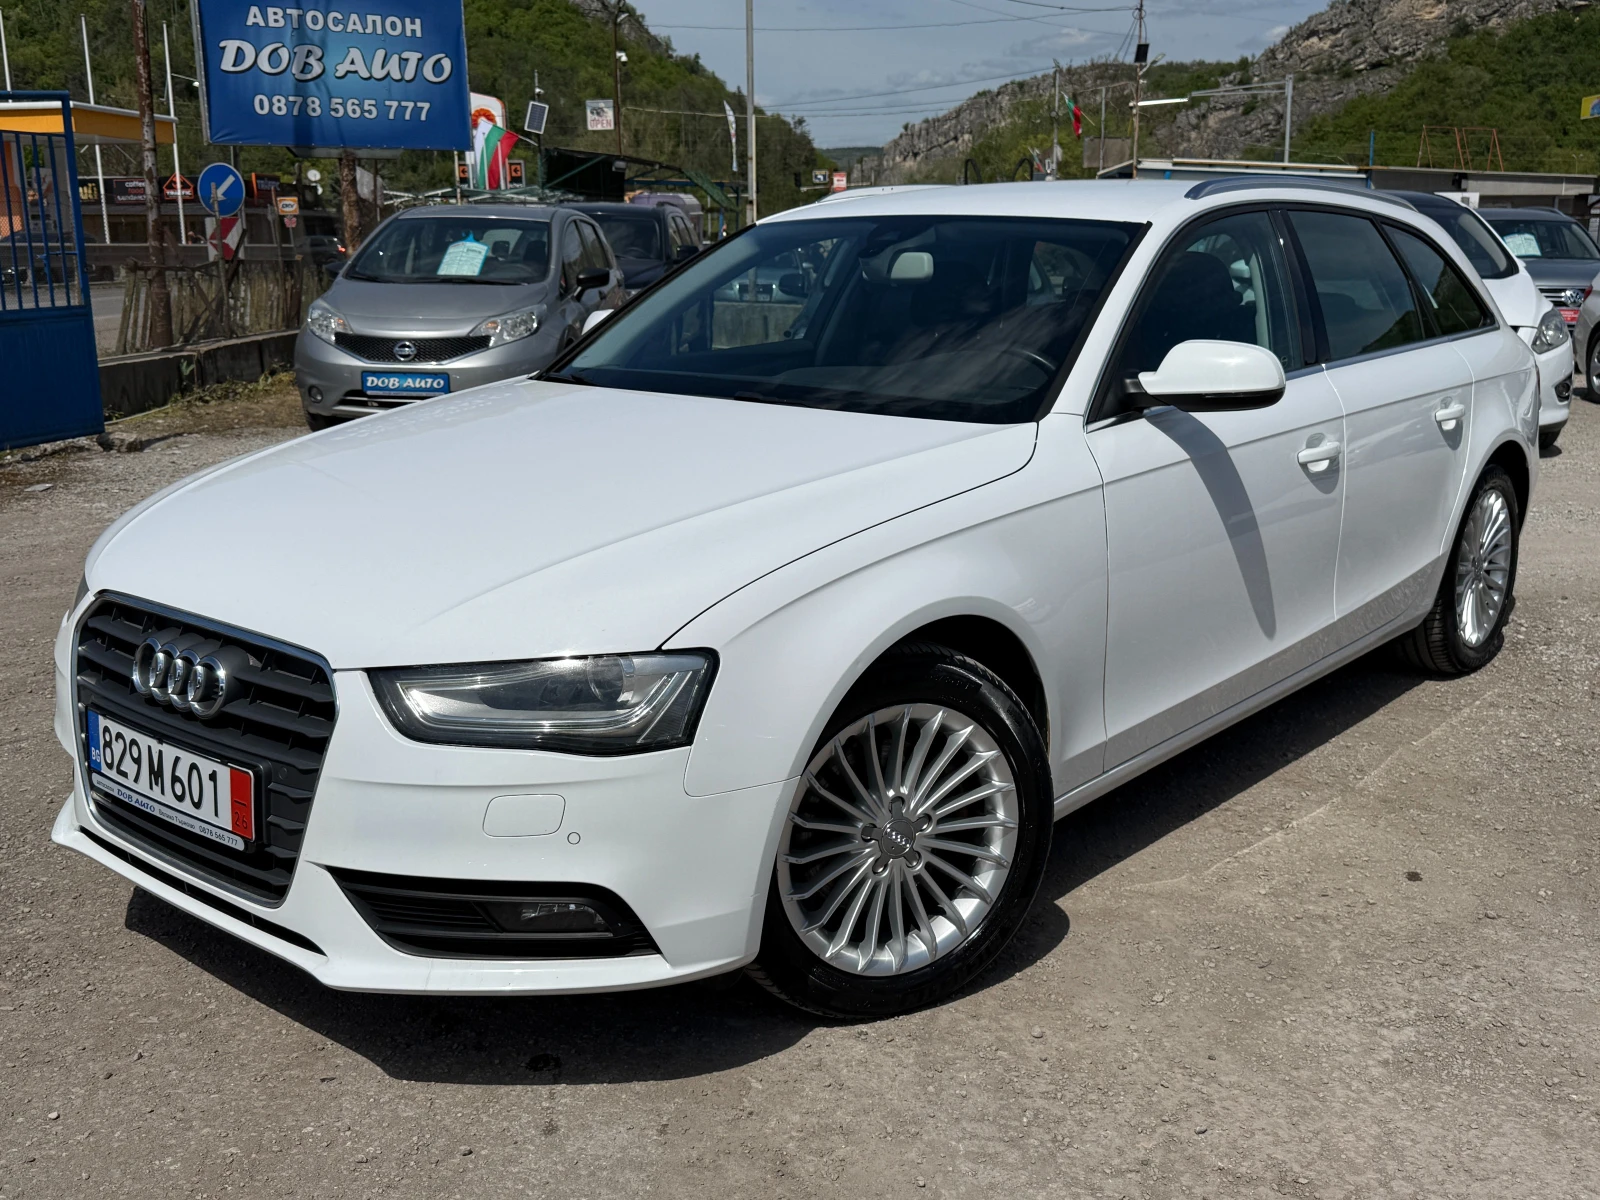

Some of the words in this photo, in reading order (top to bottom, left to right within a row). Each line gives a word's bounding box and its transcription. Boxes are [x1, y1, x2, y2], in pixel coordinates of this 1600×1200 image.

[246, 5, 422, 38] АВТОСАЛОН
[219, 39, 325, 81] DOB
[335, 47, 452, 83] AUTO
[253, 94, 322, 117] 0878
[329, 98, 378, 119] 565
[384, 100, 431, 121] 777
[366, 376, 400, 389] DOB
[403, 377, 444, 389] AUTO
[91, 747, 101, 763] BG
[117, 788, 133, 803] DOB
[134, 800, 155, 813] AUTO
[234, 811, 248, 830] 26
